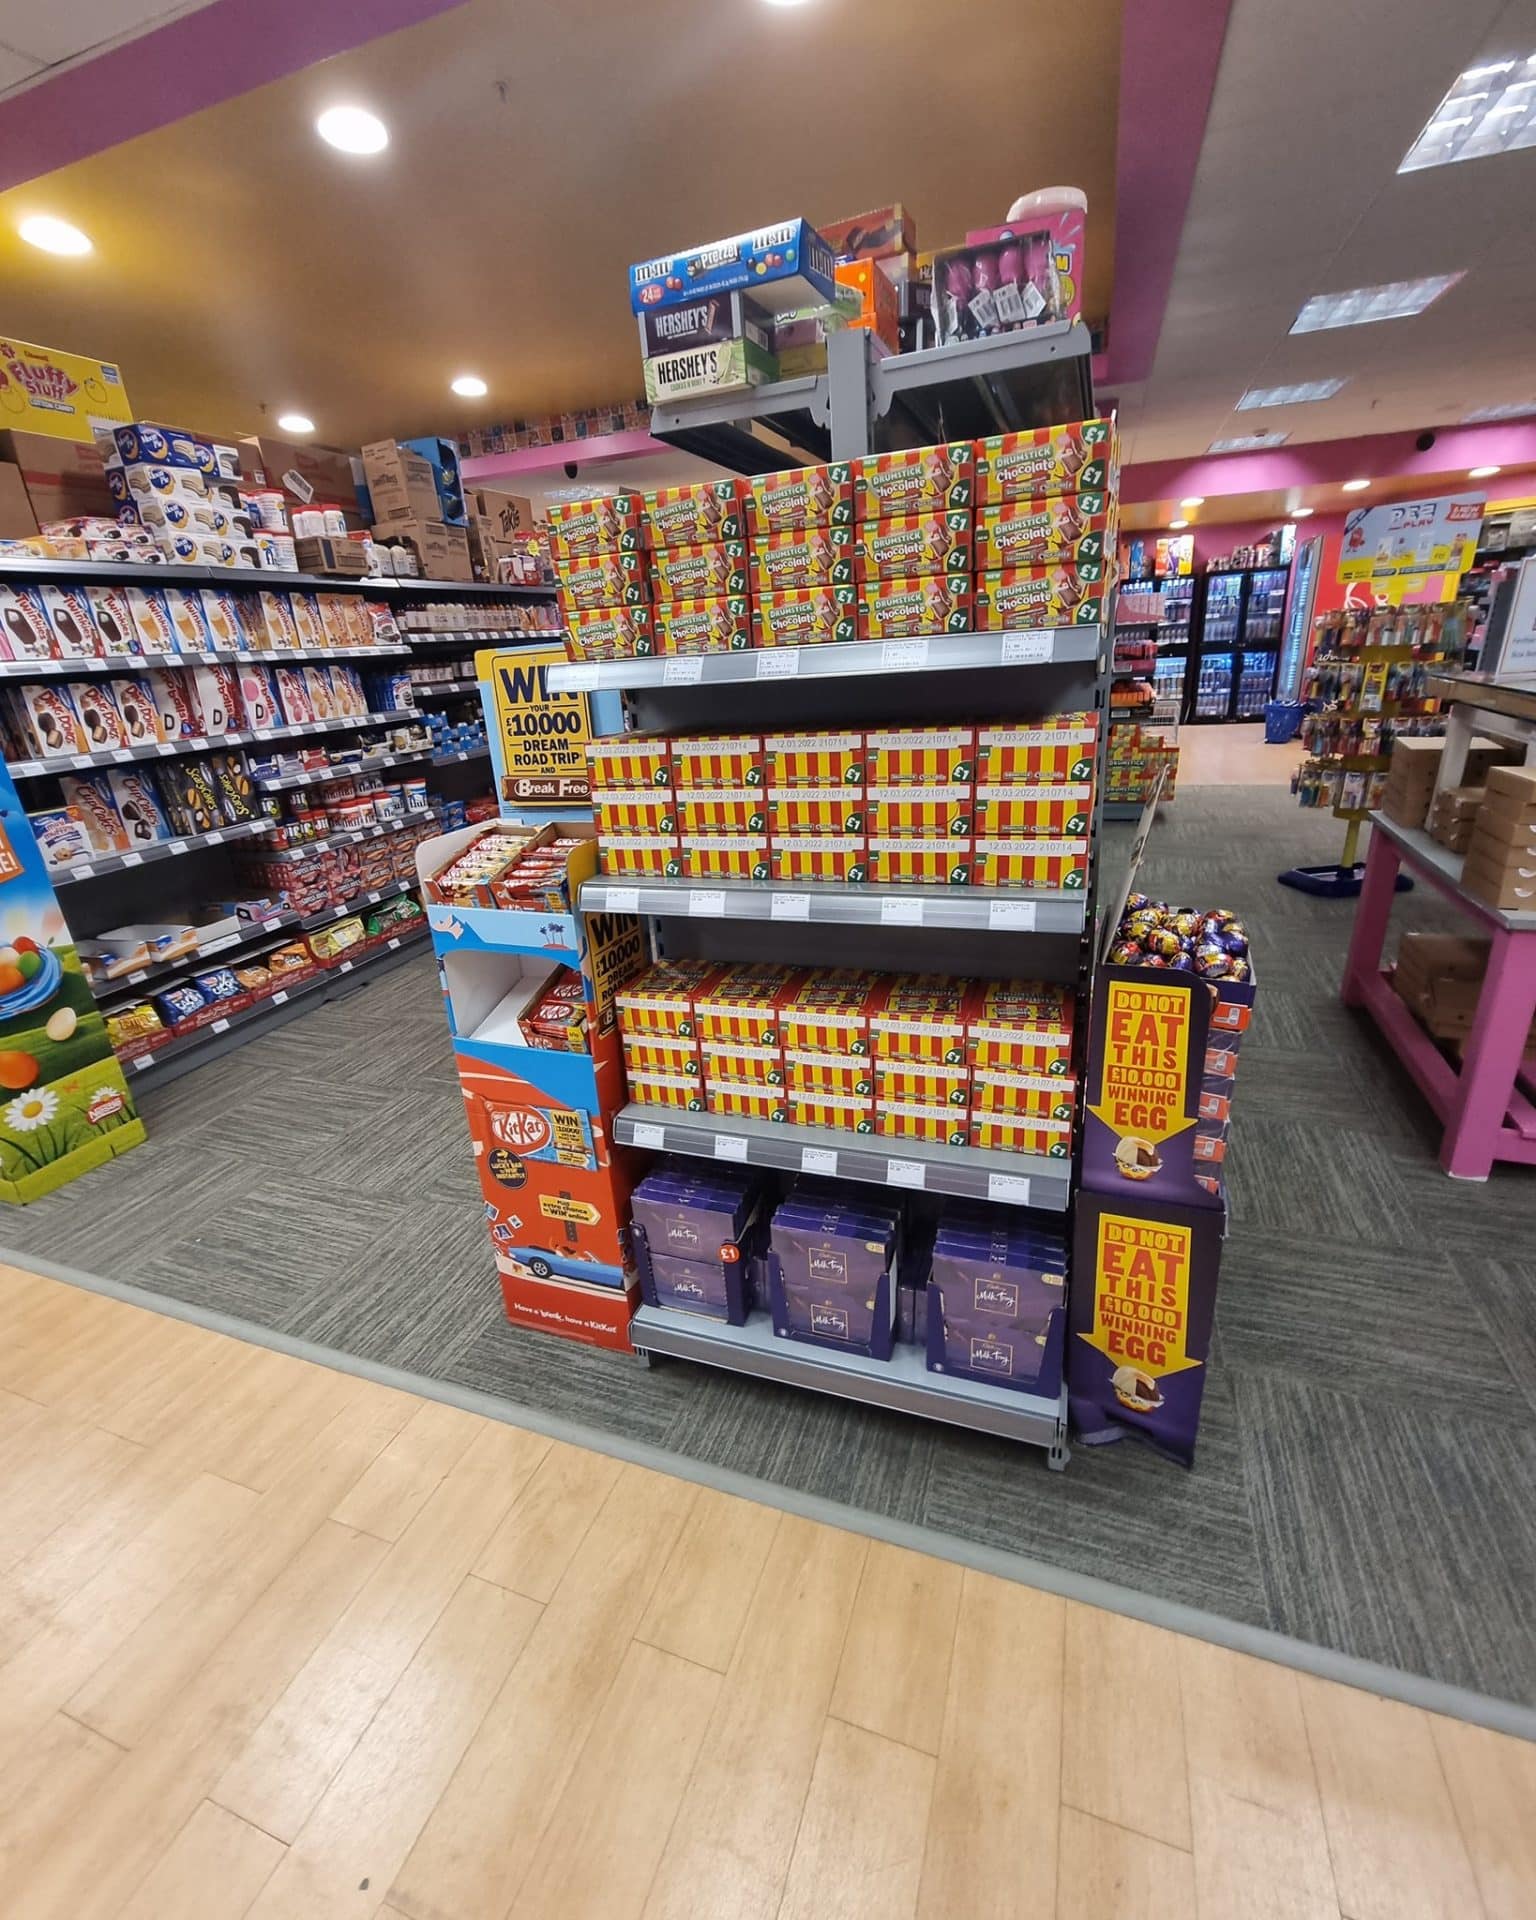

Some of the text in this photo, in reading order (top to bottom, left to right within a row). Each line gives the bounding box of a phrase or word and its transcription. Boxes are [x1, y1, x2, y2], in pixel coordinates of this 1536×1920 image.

[656, 305, 708, 338] HERSHEY'S
[658, 350, 718, 385] HERSHEY'S
[1085, 426, 1105, 443] £1
[951, 448, 969, 464] £1
[996, 445, 1052, 468] DRUMSTICK
[873, 465, 922, 485] DRUMSTICK
[996, 458, 1056, 484] Chocolate
[1082, 467, 1102, 485] £1
[875, 478, 926, 497] hocolate
[951, 486, 969, 502] £1
[763, 495, 811, 517] Chocolate
[834, 505, 850, 522] £1
[1081, 497, 1101, 513] £1
[950, 515, 967, 531] £1
[995, 514, 1048, 535] DRUMSTICK
[874, 530, 921, 548] DRUMSTICK
[995, 527, 1053, 549] Chocolate
[1080, 538, 1100, 556] £1
[874, 543, 925, 562] Chocolate
[948, 551, 966, 567] £1
[766, 556, 812, 575] Chocolate
[834, 564, 849, 579] £1
[1079, 564, 1099, 581] £1
[950, 579, 967, 594] £1
[996, 580, 1048, 599] DRUMSTICK
[875, 592, 922, 609] DRUMSTICK
[996, 591, 1052, 613] Chocolate
[15, 594, 48, 640] Twinkies
[876, 605, 926, 622] Chocolate
[950, 613, 966, 629] £1
[1078, 604, 1098, 621] £1
[771, 613, 817, 631] Chocolate
[837, 622, 853, 637] £1
[530, 704, 550, 713] YOUR
[523, 739, 569, 752] DREAM
[514, 754, 548, 766] ROAD
[953, 765, 970, 780] £1
[1072, 762, 1090, 778] £1
[518, 778, 588, 797] Break Free
[1068, 816, 1085, 832] £1
[1065, 870, 1082, 886] £1
[1117, 990, 1183, 1014] DO NOT
[1111, 1011, 1184, 1048] EAT
[1113, 1043, 1177, 1070] THIS
[1051, 1060, 1066, 1074] £1
[1108, 1084, 1177, 1107] WINNING
[554, 1114, 579, 1127] WIN
[1055, 1106, 1070, 1120] £1
[1114, 1103, 1167, 1131] EGG
[496, 1112, 543, 1143] KitKat
[1051, 1143, 1066, 1157] £1
[1108, 1224, 1184, 1252] DO NOT
[720, 1248, 735, 1259] £1
[1103, 1243, 1185, 1286] EAT
[1105, 1274, 1177, 1307] THIS
[1100, 1313, 1177, 1345] WINNING
[1108, 1331, 1167, 1367] EGG
